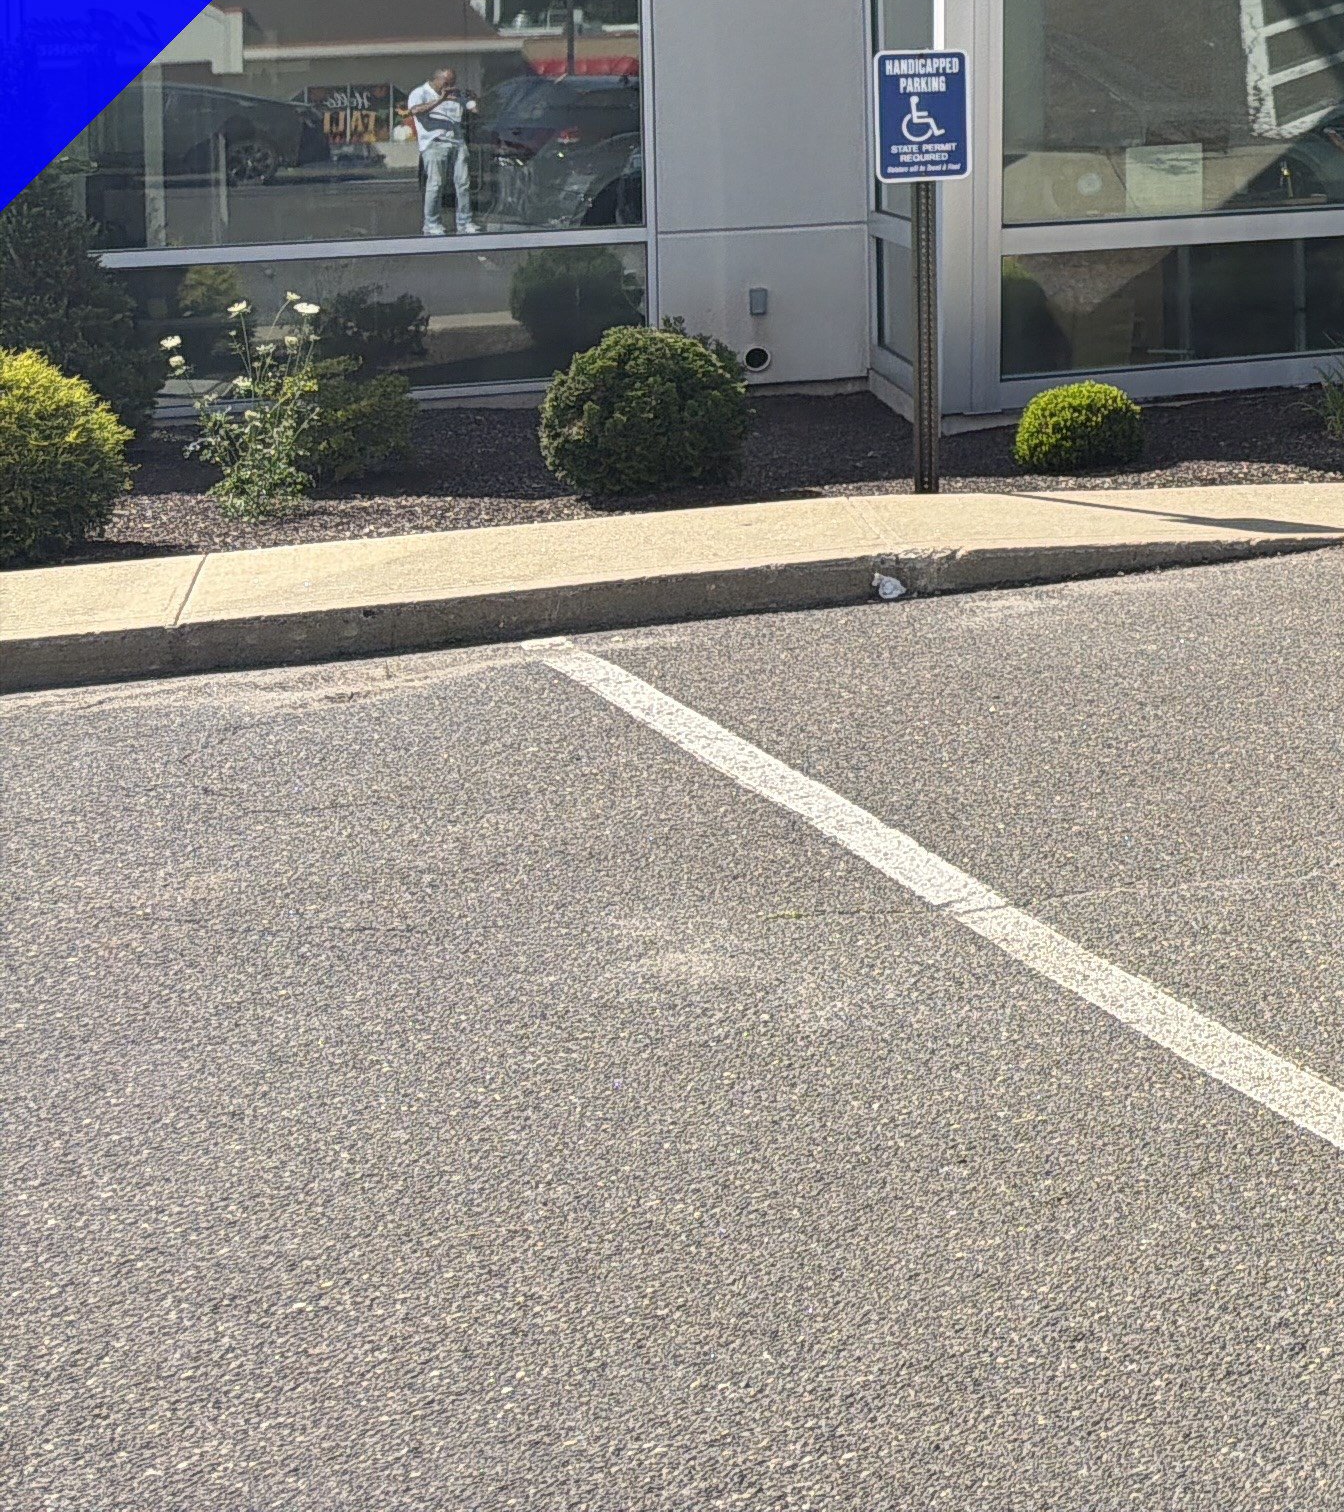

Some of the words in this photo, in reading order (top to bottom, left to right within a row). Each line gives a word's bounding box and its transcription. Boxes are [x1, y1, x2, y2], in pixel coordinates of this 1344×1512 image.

[885, 57, 960, 76] HANDICAPPED
[899, 75, 947, 94] PARKING
[890, 144, 920, 154] STATE
[922, 142, 958, 153] PERMIT
[899, 152, 949, 163] REQUIRED
